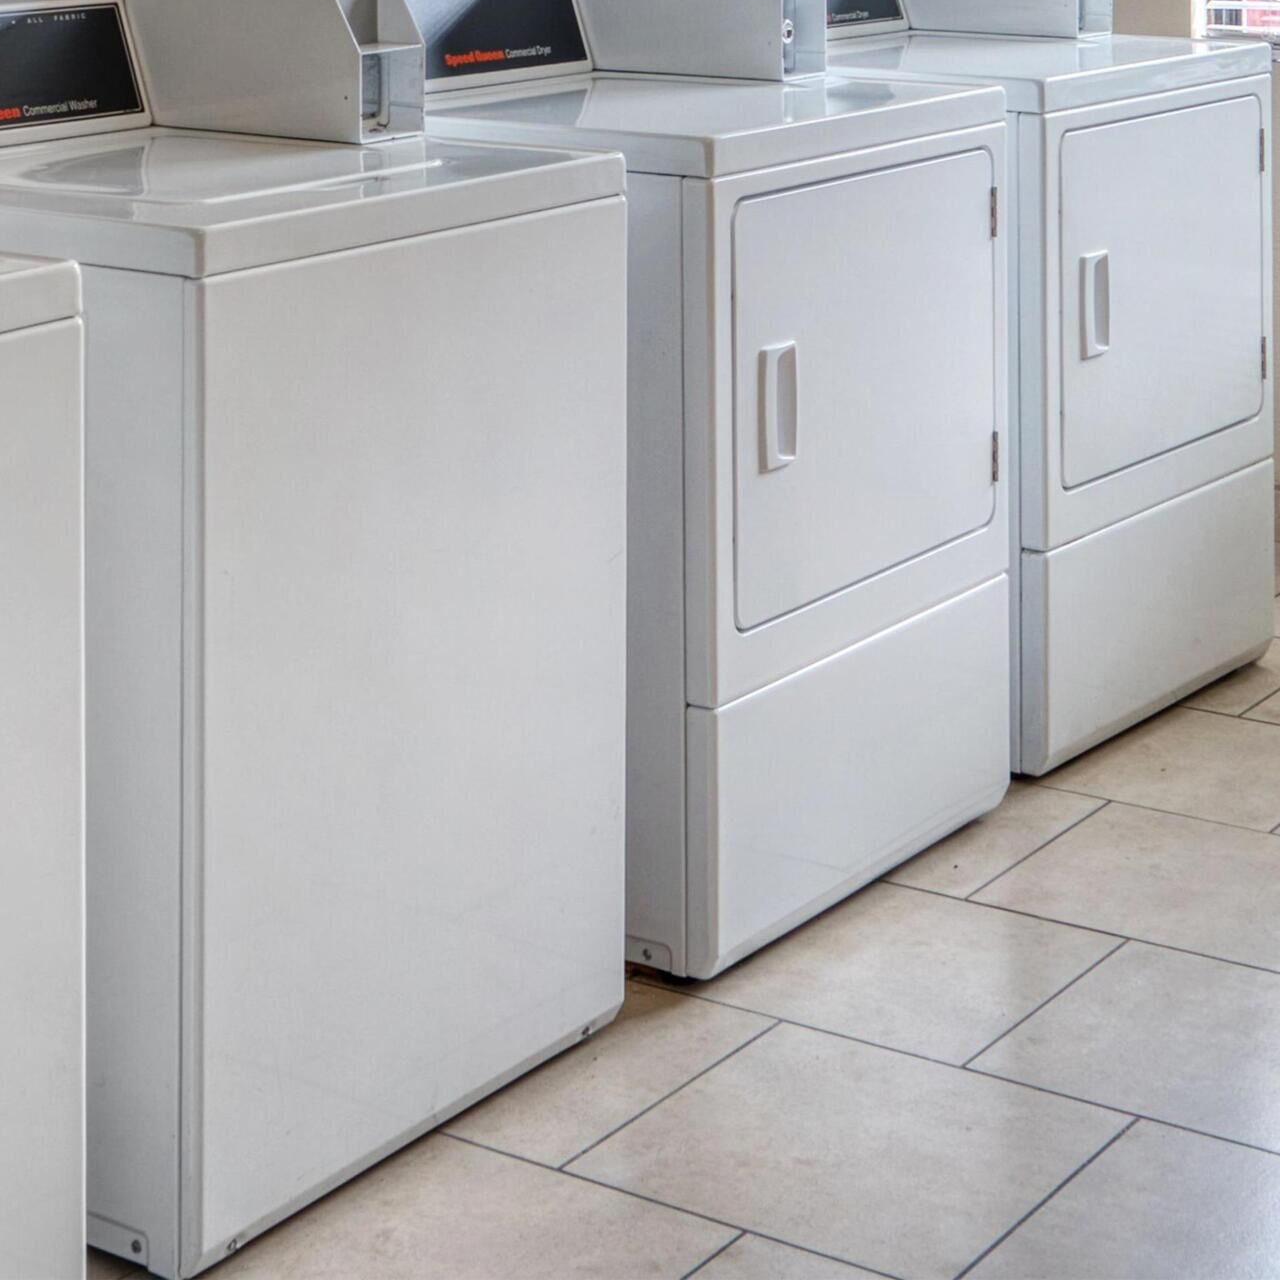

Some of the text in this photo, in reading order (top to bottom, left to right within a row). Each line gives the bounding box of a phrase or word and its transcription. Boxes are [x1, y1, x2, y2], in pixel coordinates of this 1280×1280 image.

[54, 13, 86, 21] FABRIC
[445, 51, 474, 67] Speed
[24, 101, 68, 116] Commercial
[69, 99, 97, 111] Washer
